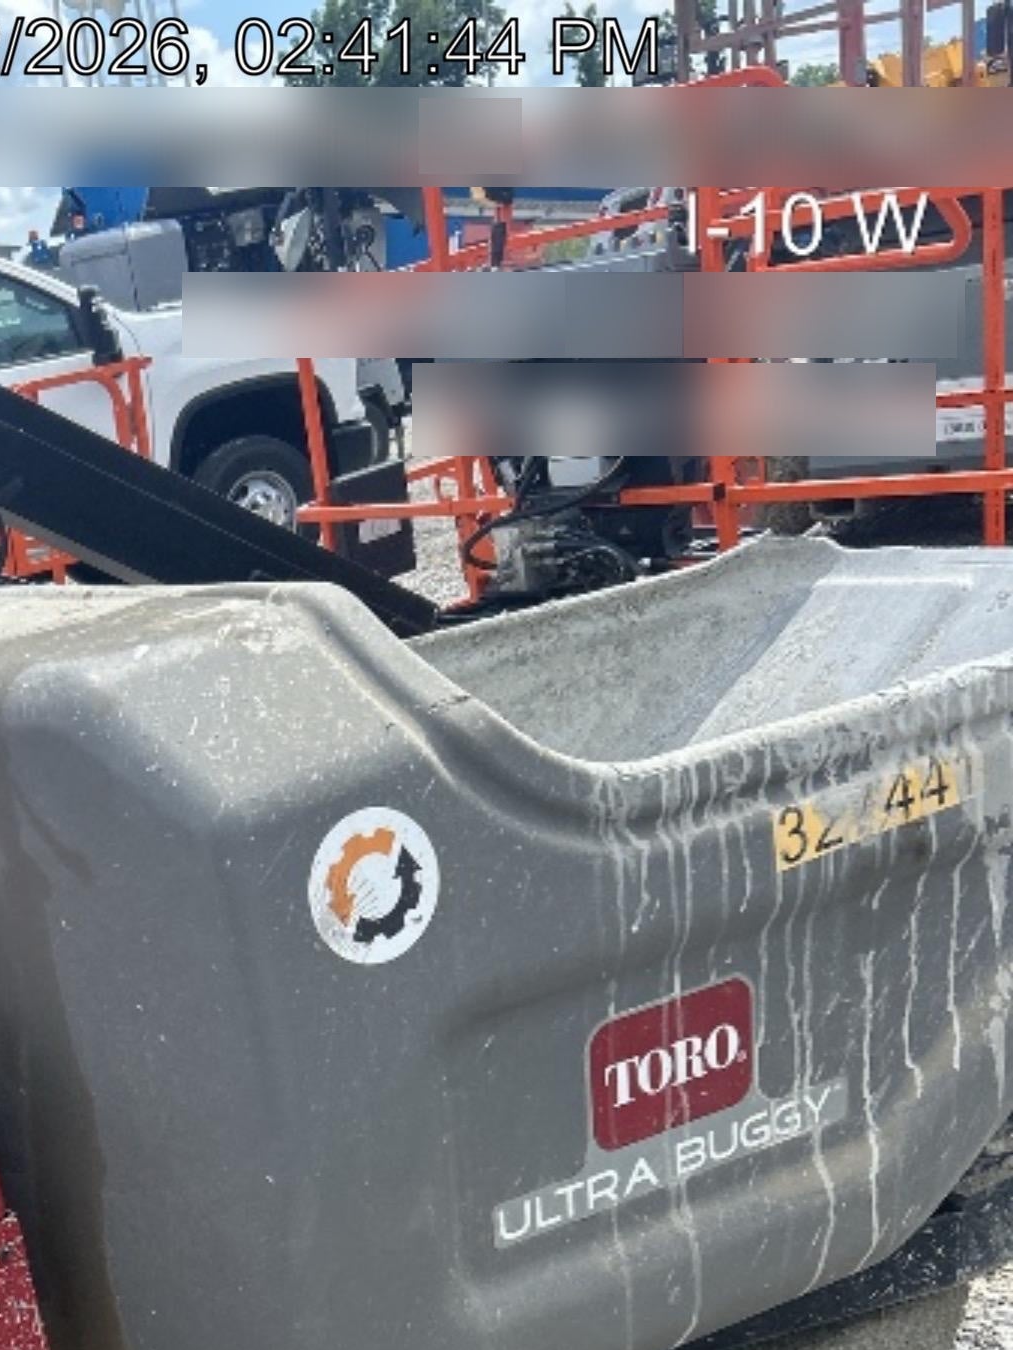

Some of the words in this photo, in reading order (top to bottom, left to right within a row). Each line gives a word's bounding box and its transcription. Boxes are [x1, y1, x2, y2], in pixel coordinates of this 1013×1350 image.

[604, 1023, 741, 1108] TORO
[498, 1156, 660, 1241] ULTRA
[676, 1084, 834, 1175] BUGGY
